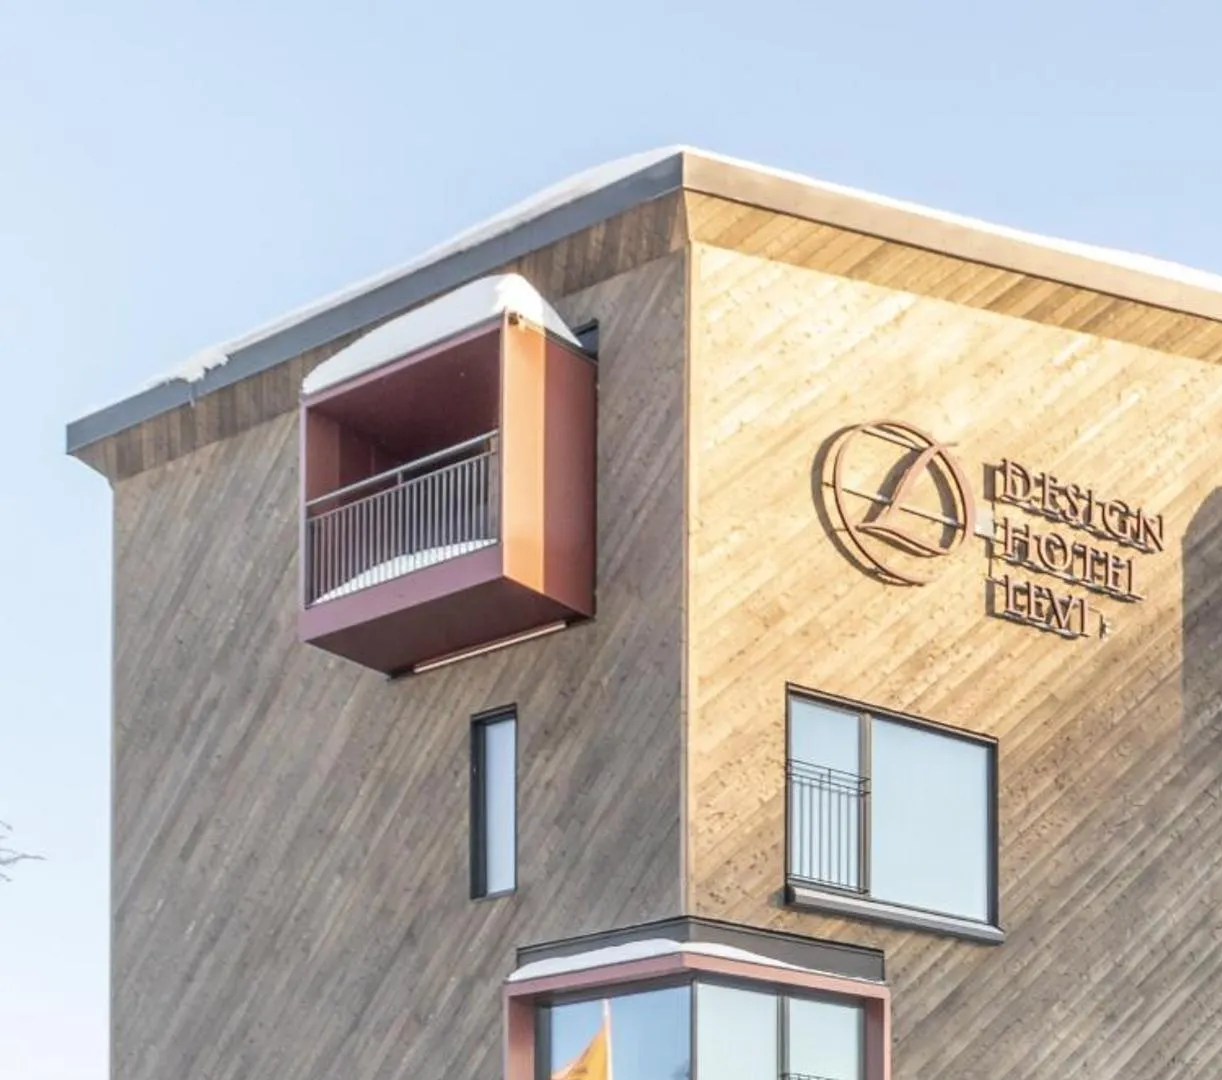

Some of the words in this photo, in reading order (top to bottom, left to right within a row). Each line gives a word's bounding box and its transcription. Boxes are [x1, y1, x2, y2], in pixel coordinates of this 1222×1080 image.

[1000, 457, 1164, 553] DESIGN
[1002, 516, 1144, 602] HOTEL
[1003, 574, 1090, 638] LEVI
